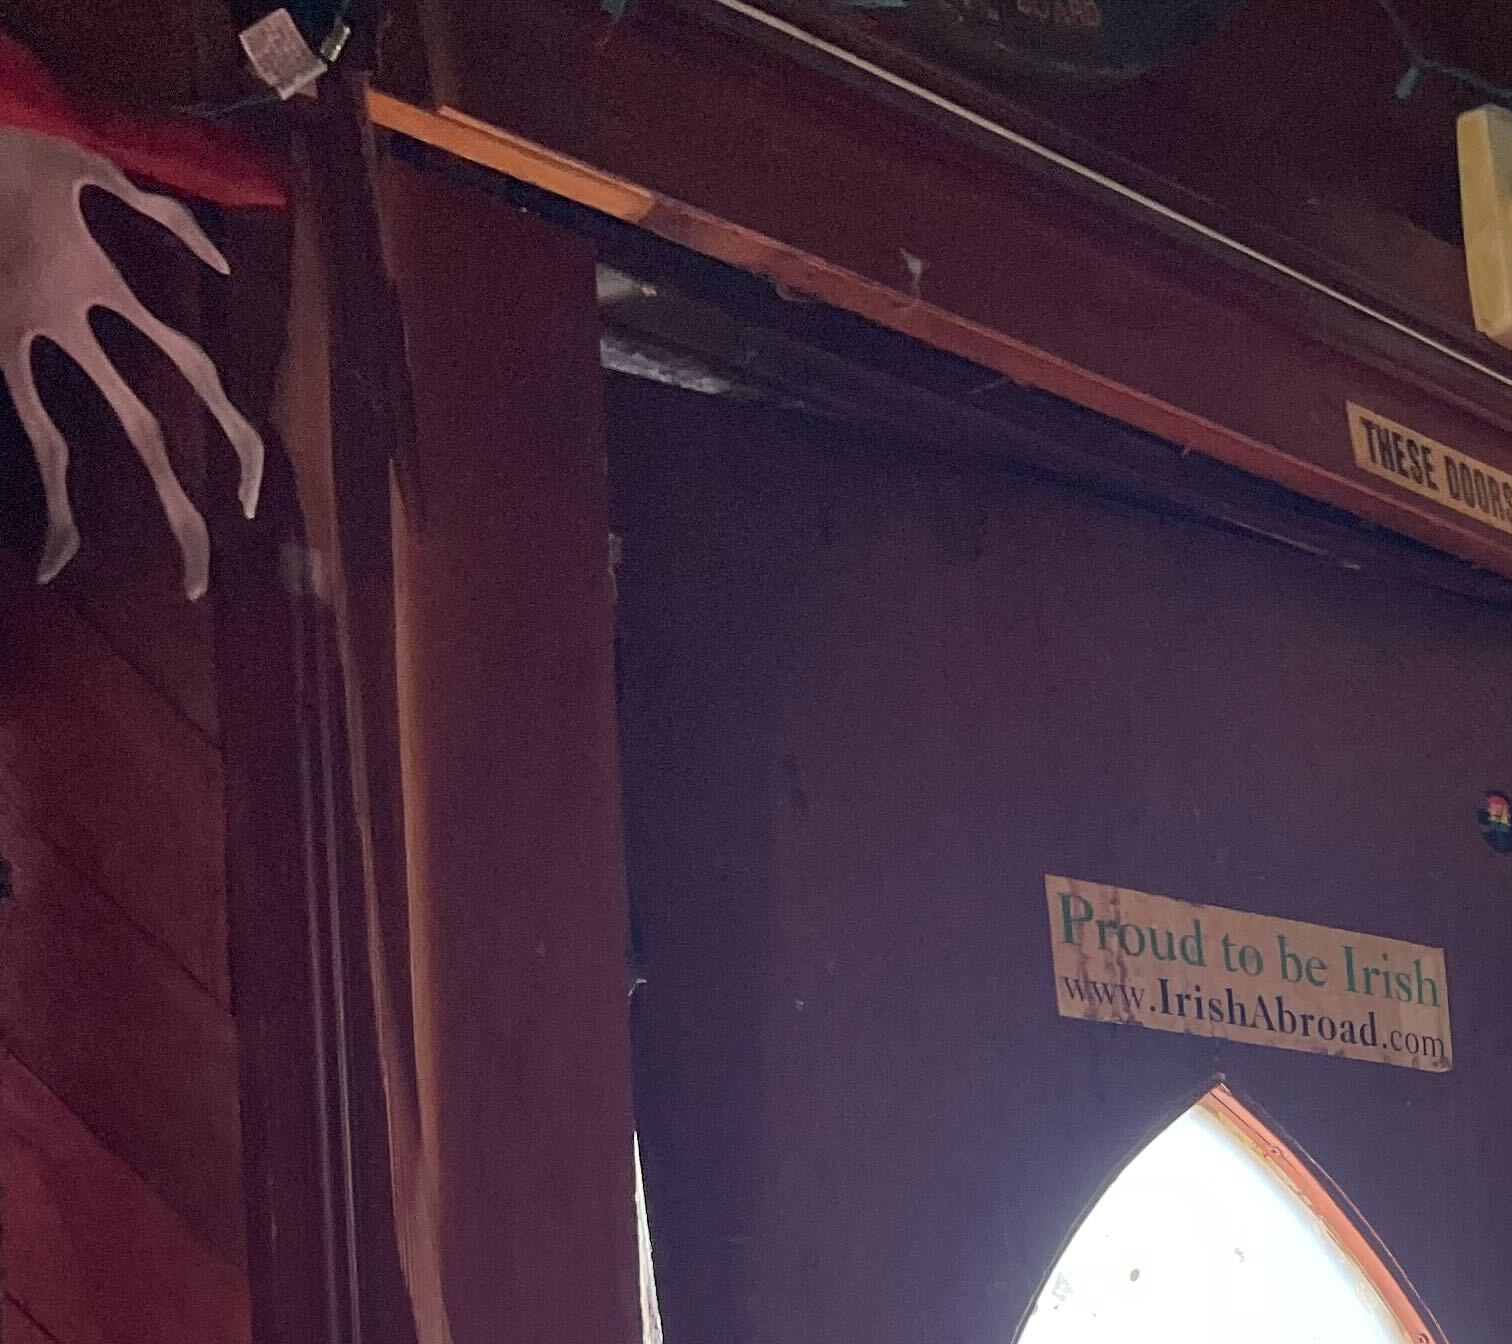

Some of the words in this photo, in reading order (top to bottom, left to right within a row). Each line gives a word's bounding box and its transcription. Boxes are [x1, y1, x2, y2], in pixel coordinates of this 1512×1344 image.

[1360, 416, 1438, 490] THESE
[1057, 891, 1206, 967] Proud
[1222, 932, 1264, 977] to
[1277, 935, 1328, 988] be
[1342, 944, 1441, 1008] Irish
[1062, 976, 1447, 1058] www.IrishAbroad.com
